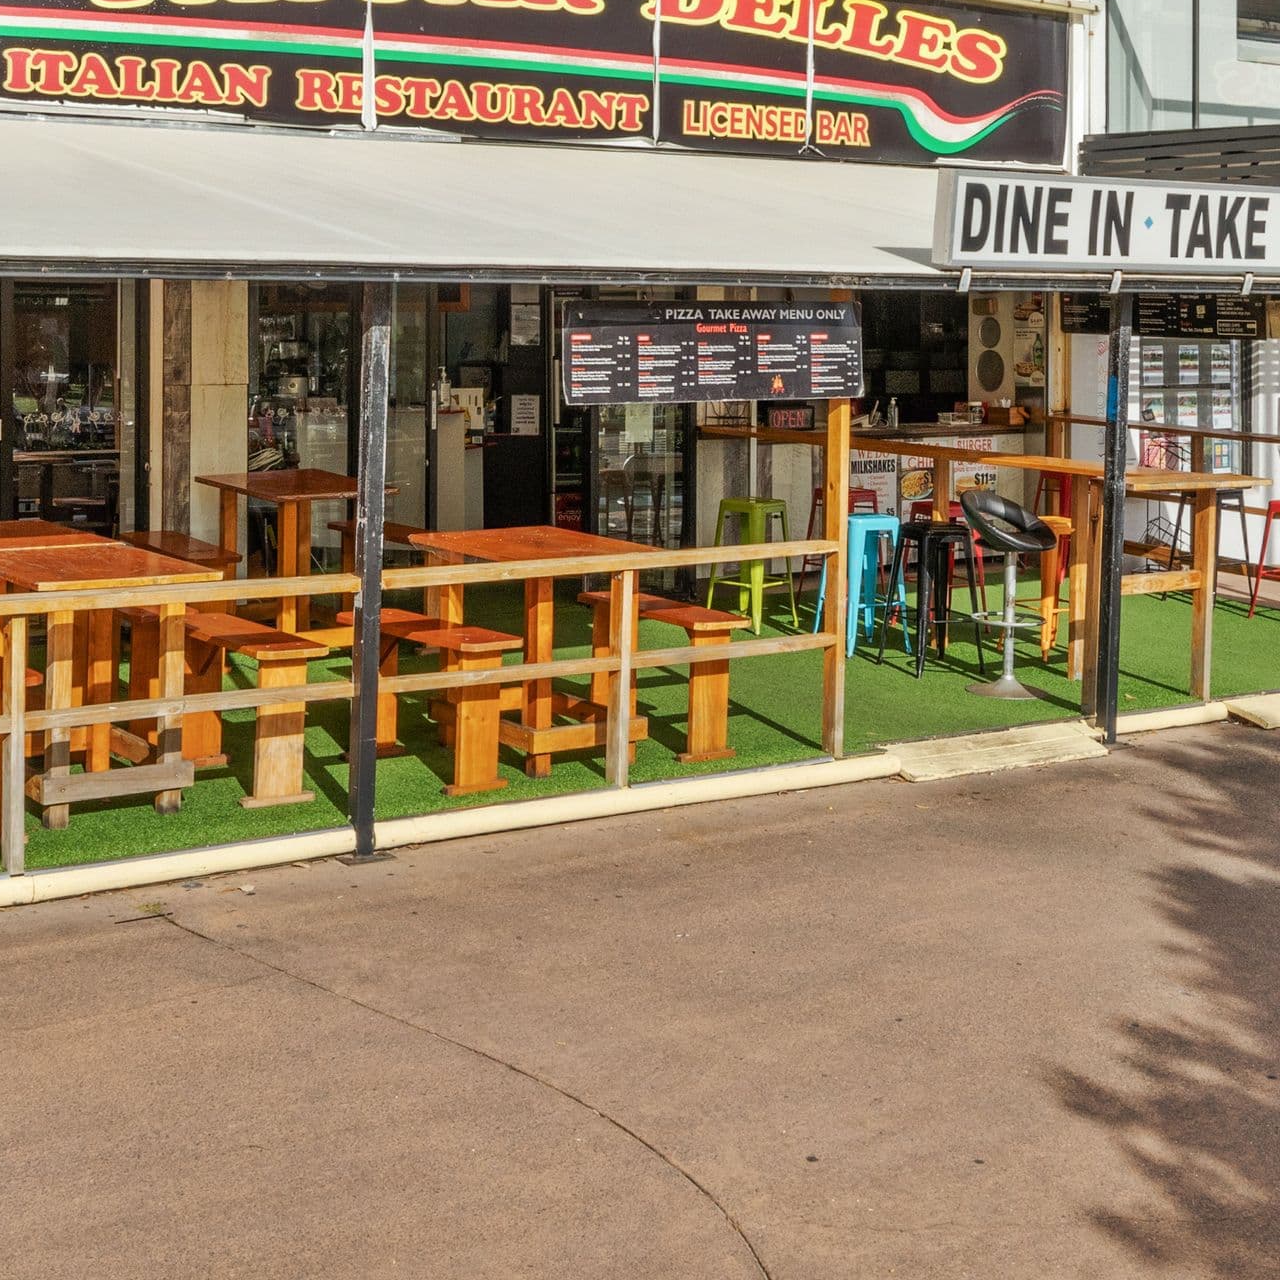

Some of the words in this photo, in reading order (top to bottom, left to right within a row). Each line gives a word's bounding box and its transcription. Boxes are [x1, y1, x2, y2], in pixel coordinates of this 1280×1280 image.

[1, 47, 272, 108] ITALIAN
[295, 68, 650, 132] RESTAURANT
[683, 99, 811, 143] LICENSED
[815, 110, 871, 147] BAR
[960, 182, 1074, 255] DINE
[1088, 190, 1135, 257] IN
[1165, 193, 1270, 260] TAKE
[666, 309, 704, 320] PIZZA
[708, 309, 740, 320] TAKE
[742, 309, 777, 320] AWAY
[780, 309, 813, 320] MENU
[816, 309, 846, 320] ONLY
[696, 323, 727, 333] Gourmet
[729, 323, 748, 333] Pizza
[773, 410, 805, 428] OPEN
[957, 438, 993, 451] BURGER
[851, 459, 896, 474] MILKSHAKES
